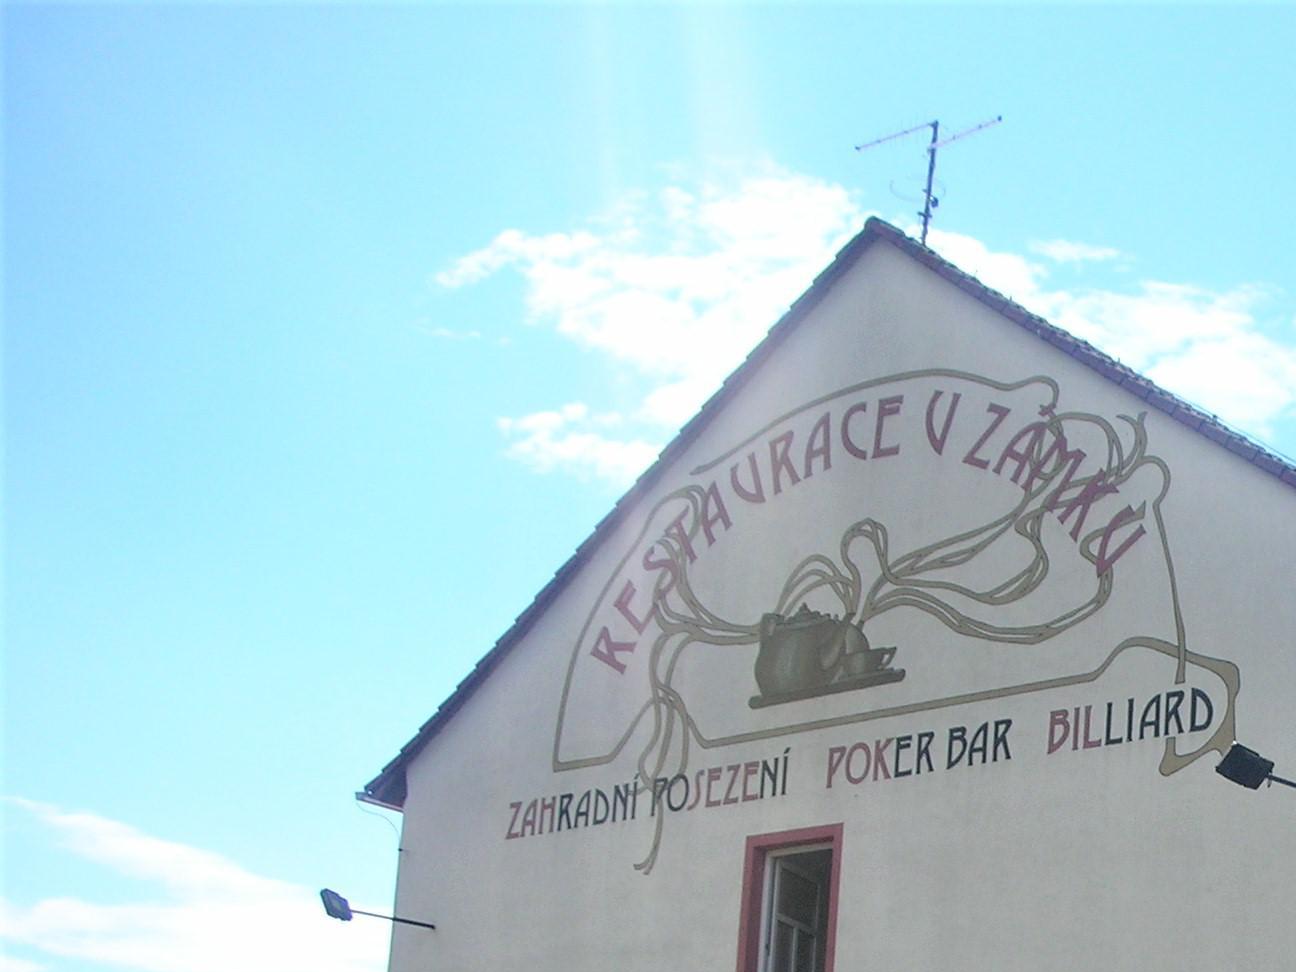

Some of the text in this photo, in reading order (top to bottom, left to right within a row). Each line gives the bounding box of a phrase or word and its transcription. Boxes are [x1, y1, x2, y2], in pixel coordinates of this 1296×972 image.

[590, 391, 1147, 675] RESTAURACE U ZÁMKU
[505, 686, 1214, 840] ZAHRADNÍ POSEZENÍ POKER BAR BILLIARD
